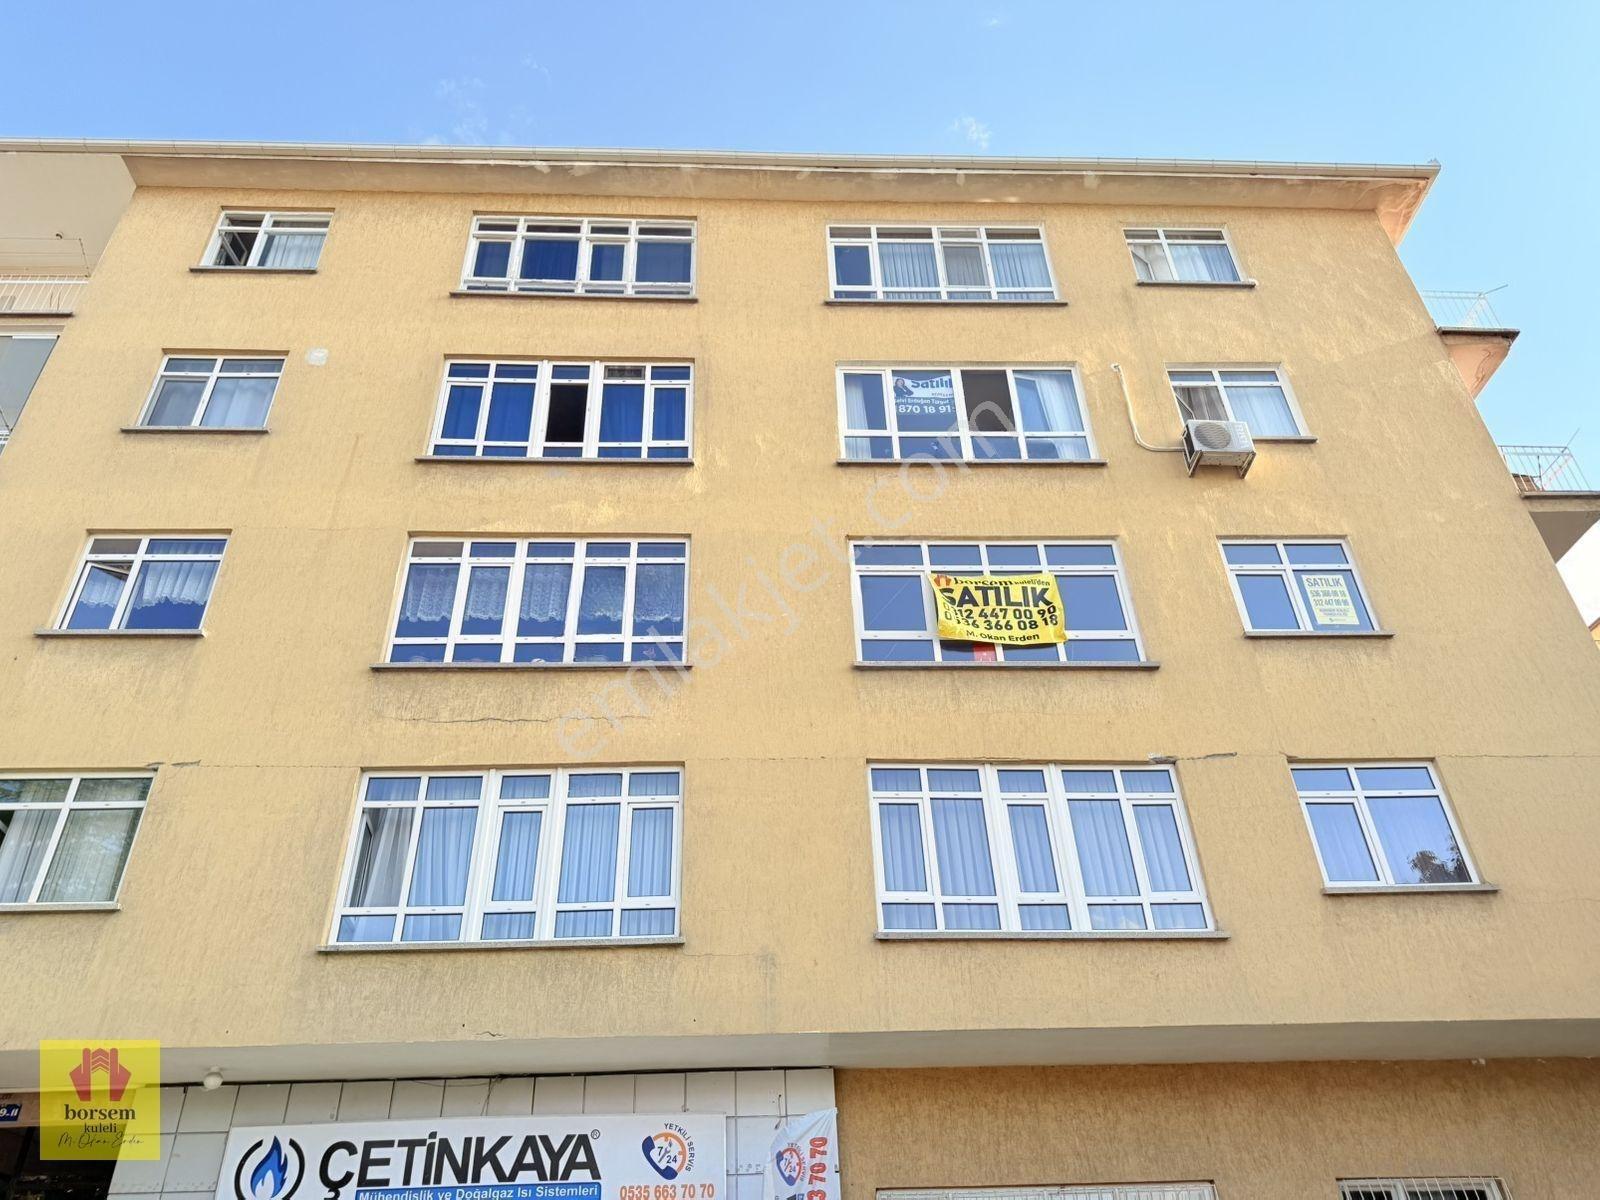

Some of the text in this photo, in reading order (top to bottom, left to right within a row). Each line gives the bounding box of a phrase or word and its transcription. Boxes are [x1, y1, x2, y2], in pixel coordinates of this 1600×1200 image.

[899, 404, 920, 413] 870
[923, 405, 936, 413] 18
[1306, 577, 1343, 587] SATILIK
[939, 586, 1053, 607] SATILIK
[979, 608, 1008, 619] 447
[1013, 608, 1033, 619] 00
[1037, 605, 1056, 618] 90
[984, 619, 1013, 630] 366
[1018, 620, 1039, 630] 08
[1042, 614, 1058, 626] 18
[979, 632, 1006, 641] Okan
[1008, 634, 1039, 642] Erden
[664, 1122, 696, 1172] YETKİLİ SERVİS
[809, 1136, 828, 1159] 70
[319, 1131, 601, 1200] ÇETİNKAYA
[666, 1155, 678, 1164] 24
[808, 1162, 827, 1185] 70
[437, 1191, 452, 1199] ve
[456, 1187, 513, 1200] Doğalgaz
[536, 1185, 598, 1197] Sistemleri
[620, 1183, 715, 1200] 0535 663 70 70
